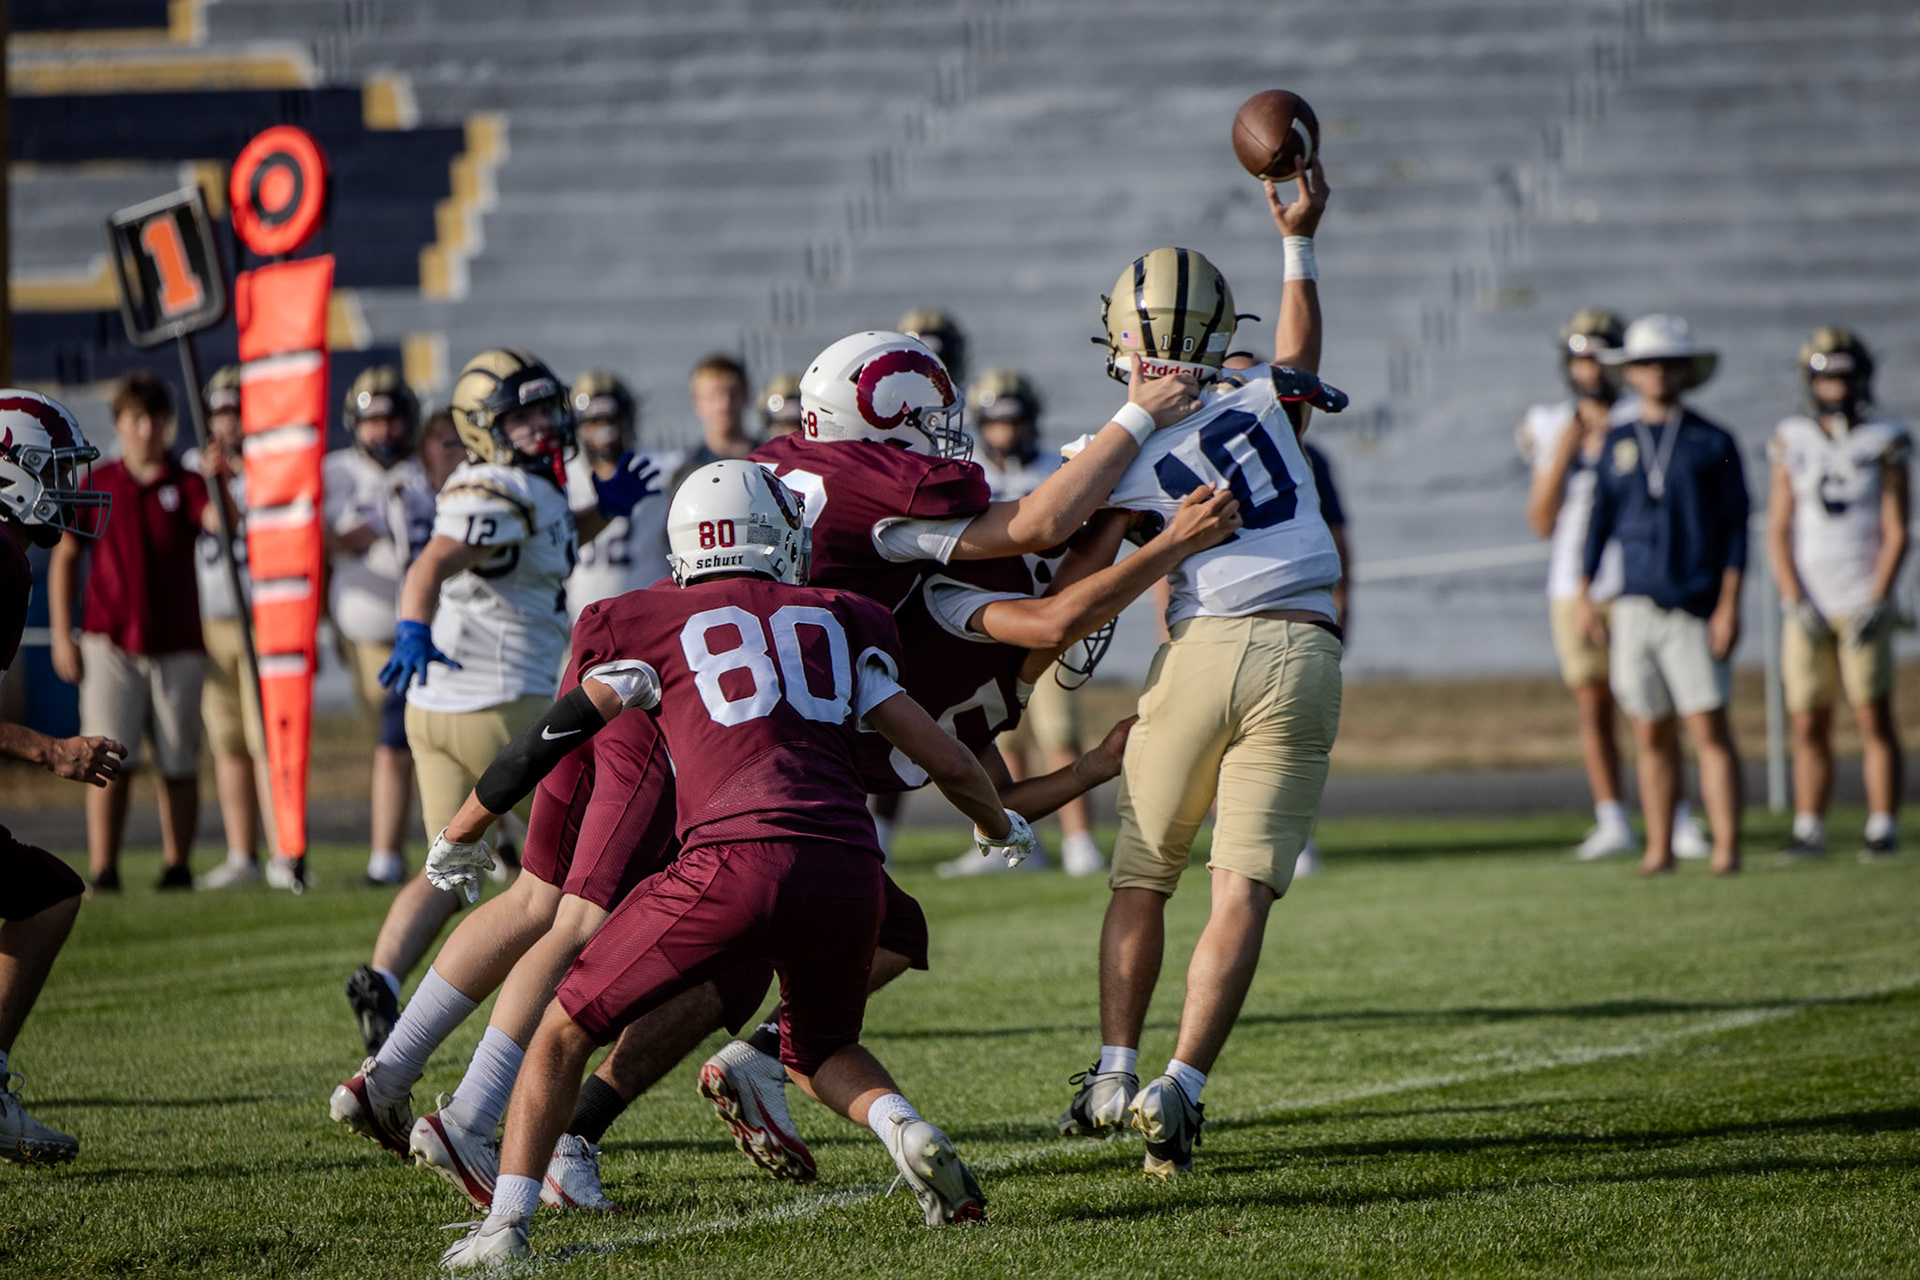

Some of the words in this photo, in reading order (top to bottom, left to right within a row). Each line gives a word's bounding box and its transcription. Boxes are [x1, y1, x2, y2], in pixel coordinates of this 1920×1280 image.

[140, 214, 205, 319] 1
[1162, 334, 1194, 353] 10
[465, 515, 497, 546] 12
[698, 519, 735, 550] 80
[680, 606, 852, 728] 80
